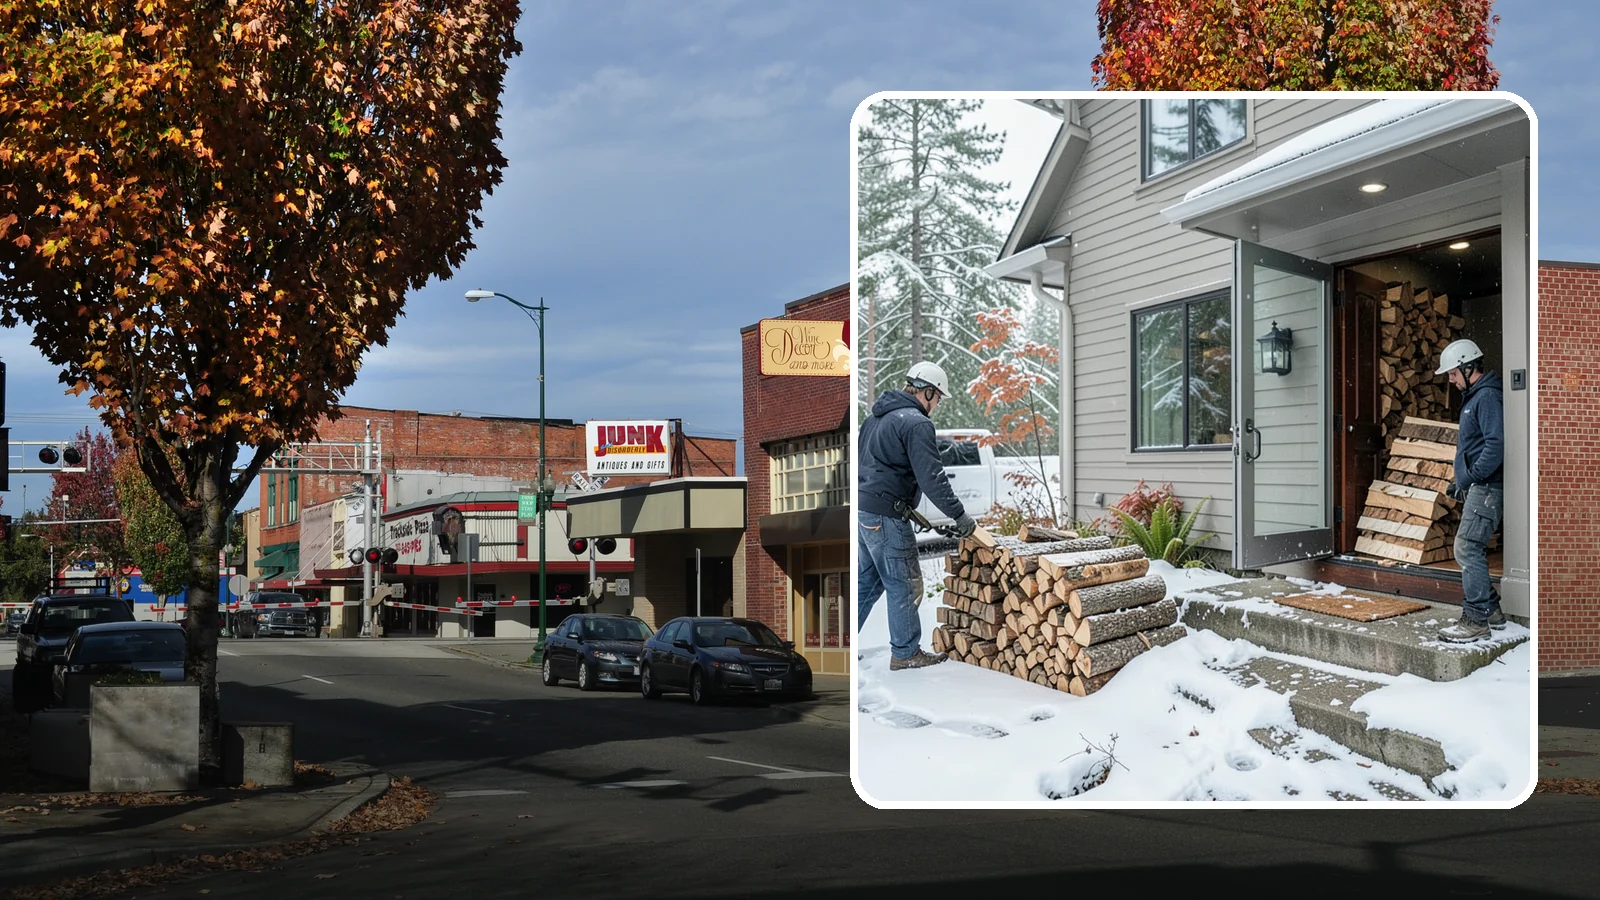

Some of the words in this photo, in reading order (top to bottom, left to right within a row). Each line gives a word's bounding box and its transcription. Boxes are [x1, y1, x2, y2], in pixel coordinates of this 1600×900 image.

[595, 425, 665, 457] JUNK
[597, 461, 628, 469] ANTIQUES
[631, 461, 643, 469] AND
[647, 461, 665, 469] GIFTS
[573, 473, 588, 490] RAIL
[390, 521, 413, 539] Trackside
[414, 519, 429, 534] Pizza
